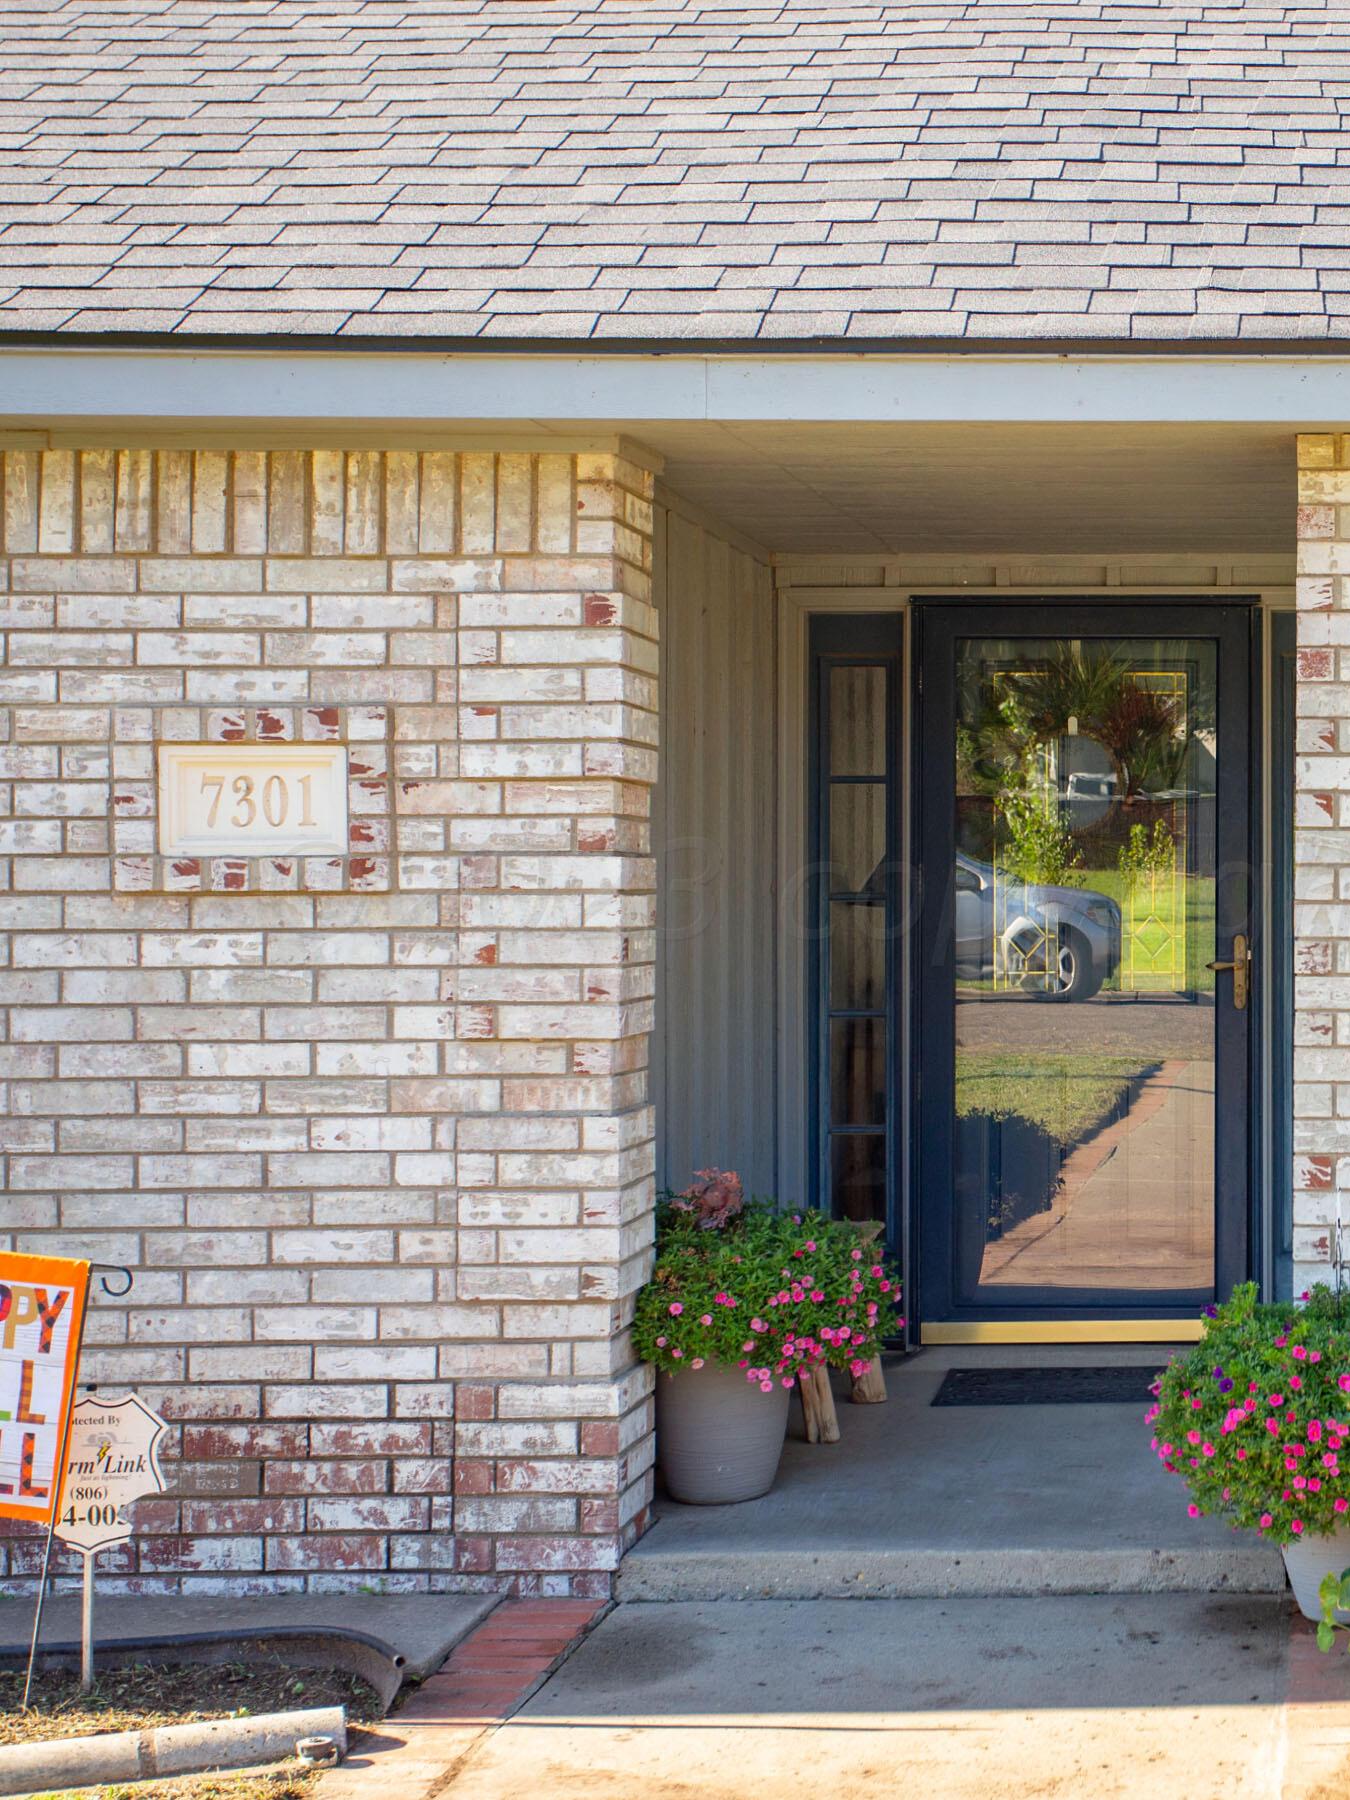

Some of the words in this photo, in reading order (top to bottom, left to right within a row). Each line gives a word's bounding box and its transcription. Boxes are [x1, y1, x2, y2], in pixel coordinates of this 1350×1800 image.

[200, 772, 317, 828] 7301
[108, 1415, 121, 1427] By
[103, 1454, 147, 1474] Link
[70, 1486, 108, 1501] (806)
